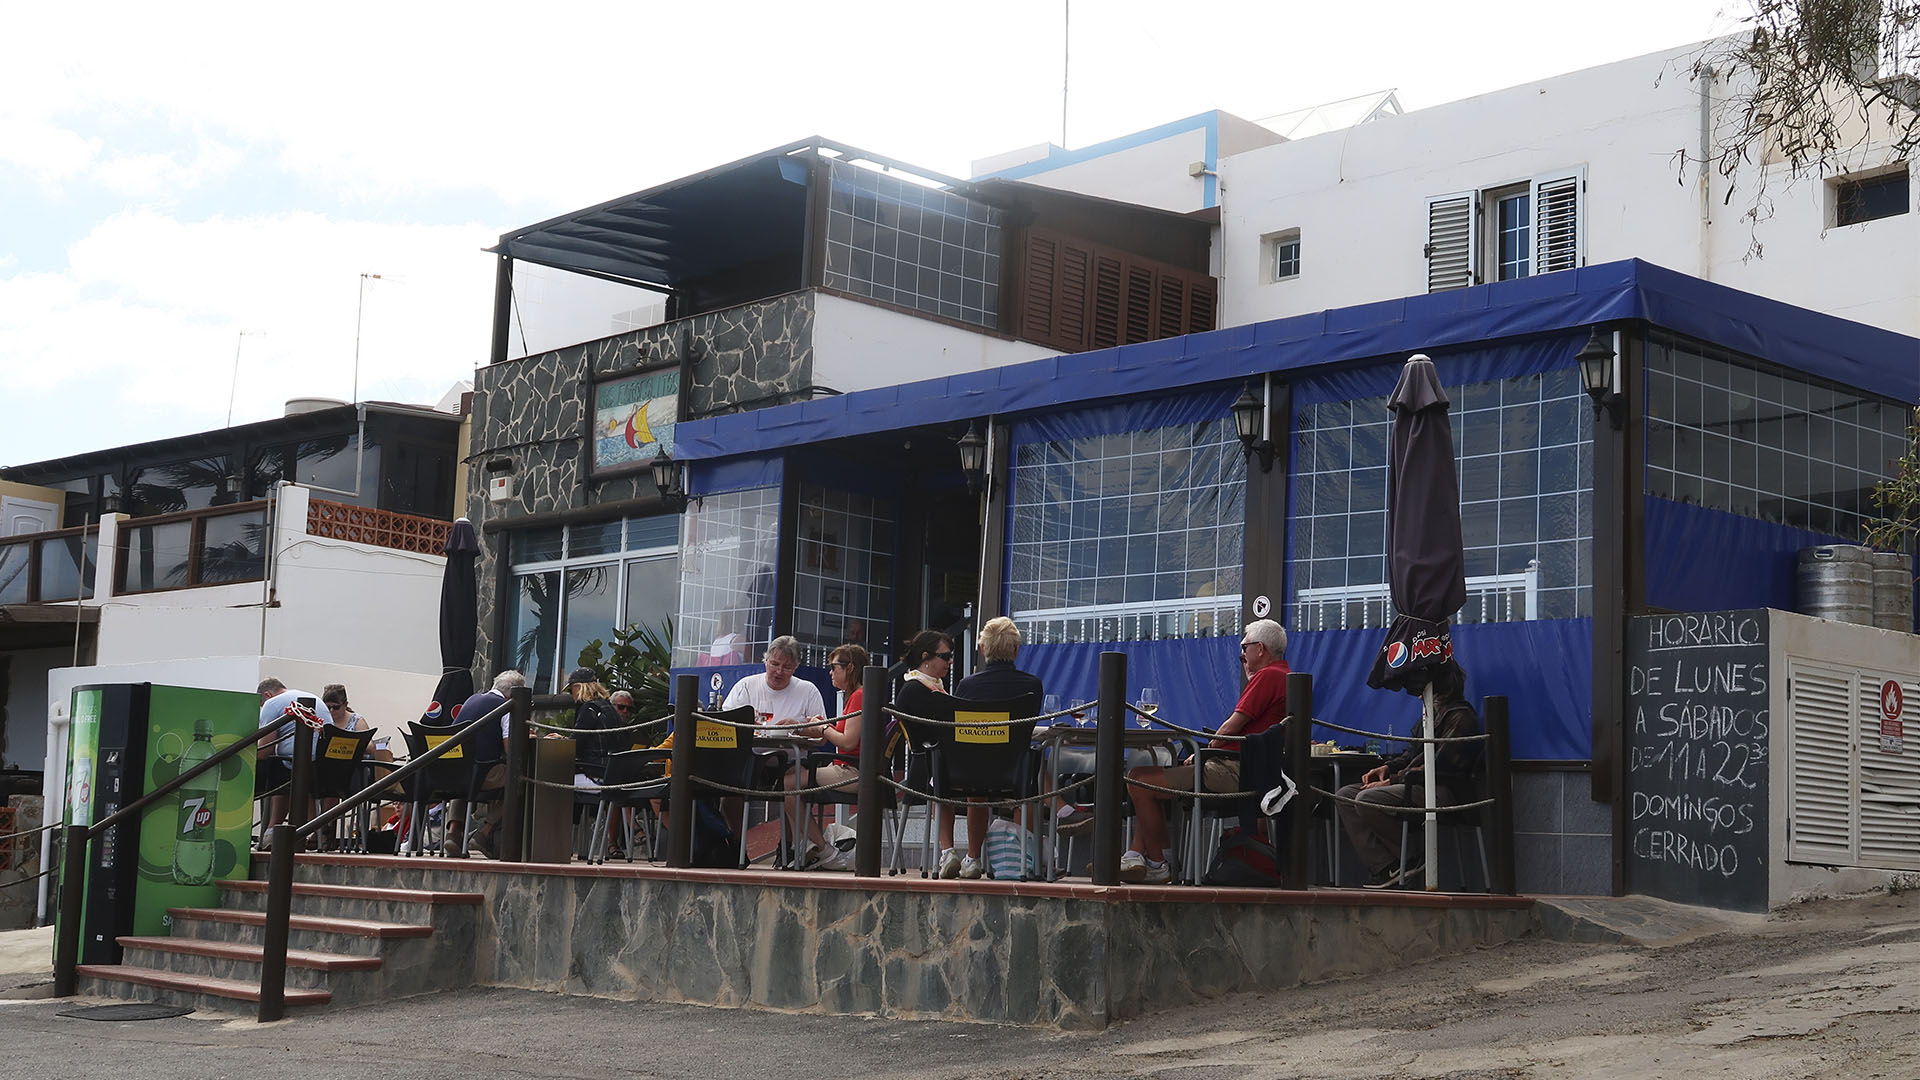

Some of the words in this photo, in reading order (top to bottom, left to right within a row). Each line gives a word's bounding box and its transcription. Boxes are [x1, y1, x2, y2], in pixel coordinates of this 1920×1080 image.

[1649, 615, 1759, 648] HORARIO
[1631, 665, 1662, 695] DE
[1674, 660, 1766, 695] LUNES
[959, 728, 1006, 736] CARACOLITOS
[1635, 705, 1647, 734] A
[1657, 699, 1768, 740] SÁBADOS
[1631, 746, 1655, 772] DE
[1658, 741, 1689, 780] 11
[1696, 748, 1706, 779] A
[1632, 793, 1753, 834] DOMINGOS
[1633, 828, 1738, 877] CERRADO
